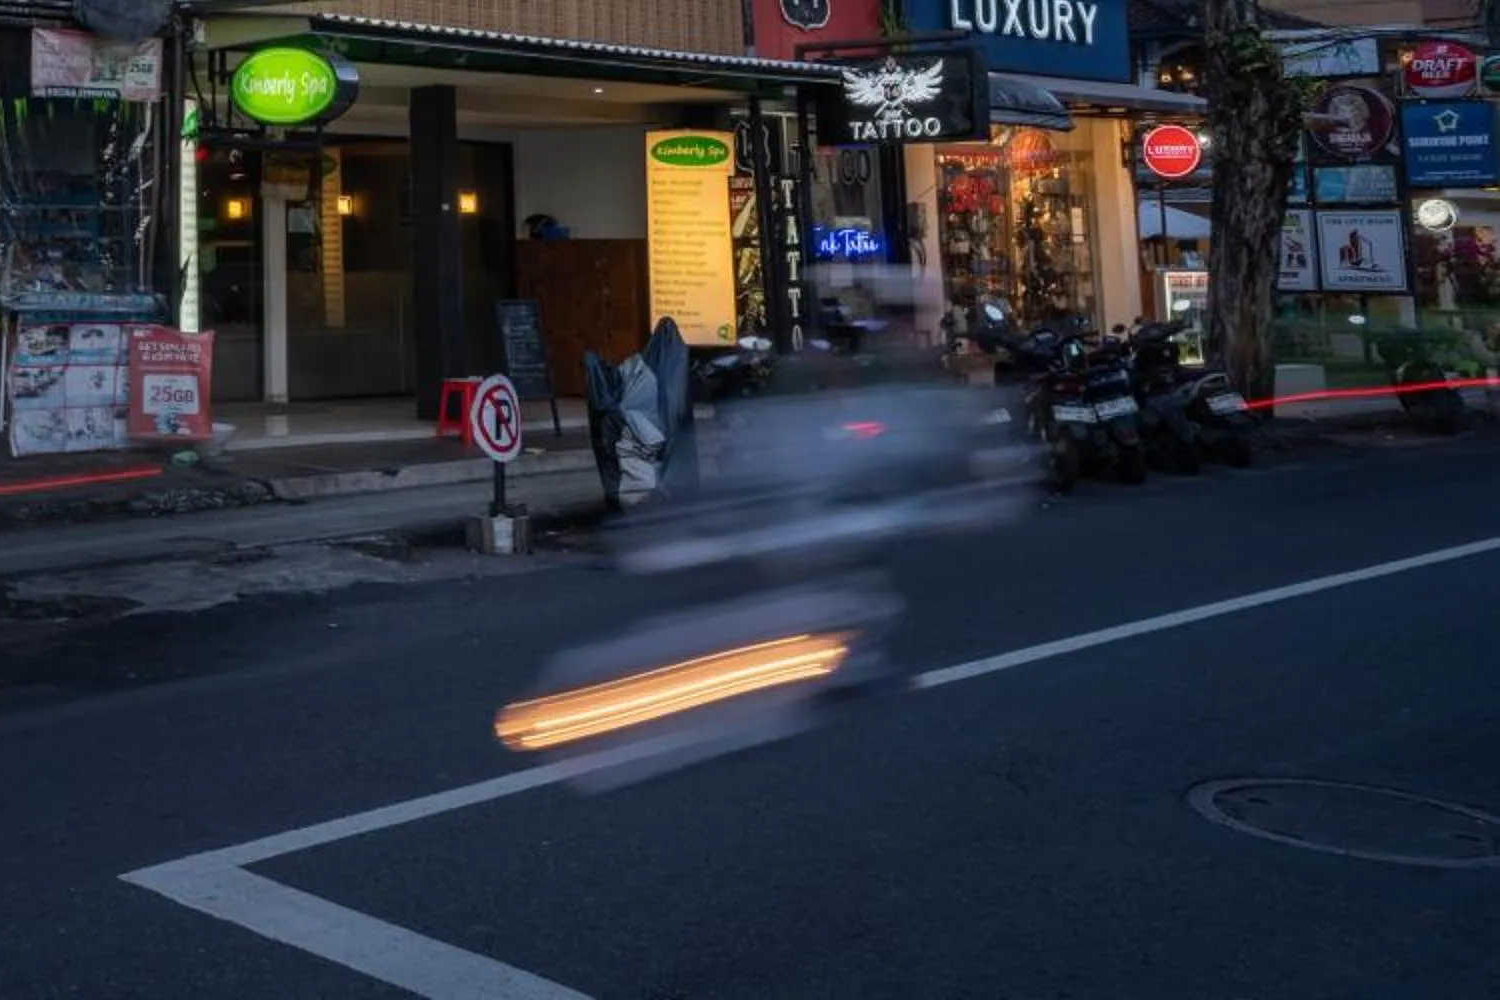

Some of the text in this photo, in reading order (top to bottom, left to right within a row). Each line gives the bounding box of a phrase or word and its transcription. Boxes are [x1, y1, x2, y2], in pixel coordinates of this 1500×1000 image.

[1411, 57, 1468, 73] DRAFT
[241, 70, 328, 104] Kimberly Spa
[848, 117, 941, 141] TATTOO
[150, 384, 195, 403] 25GB
